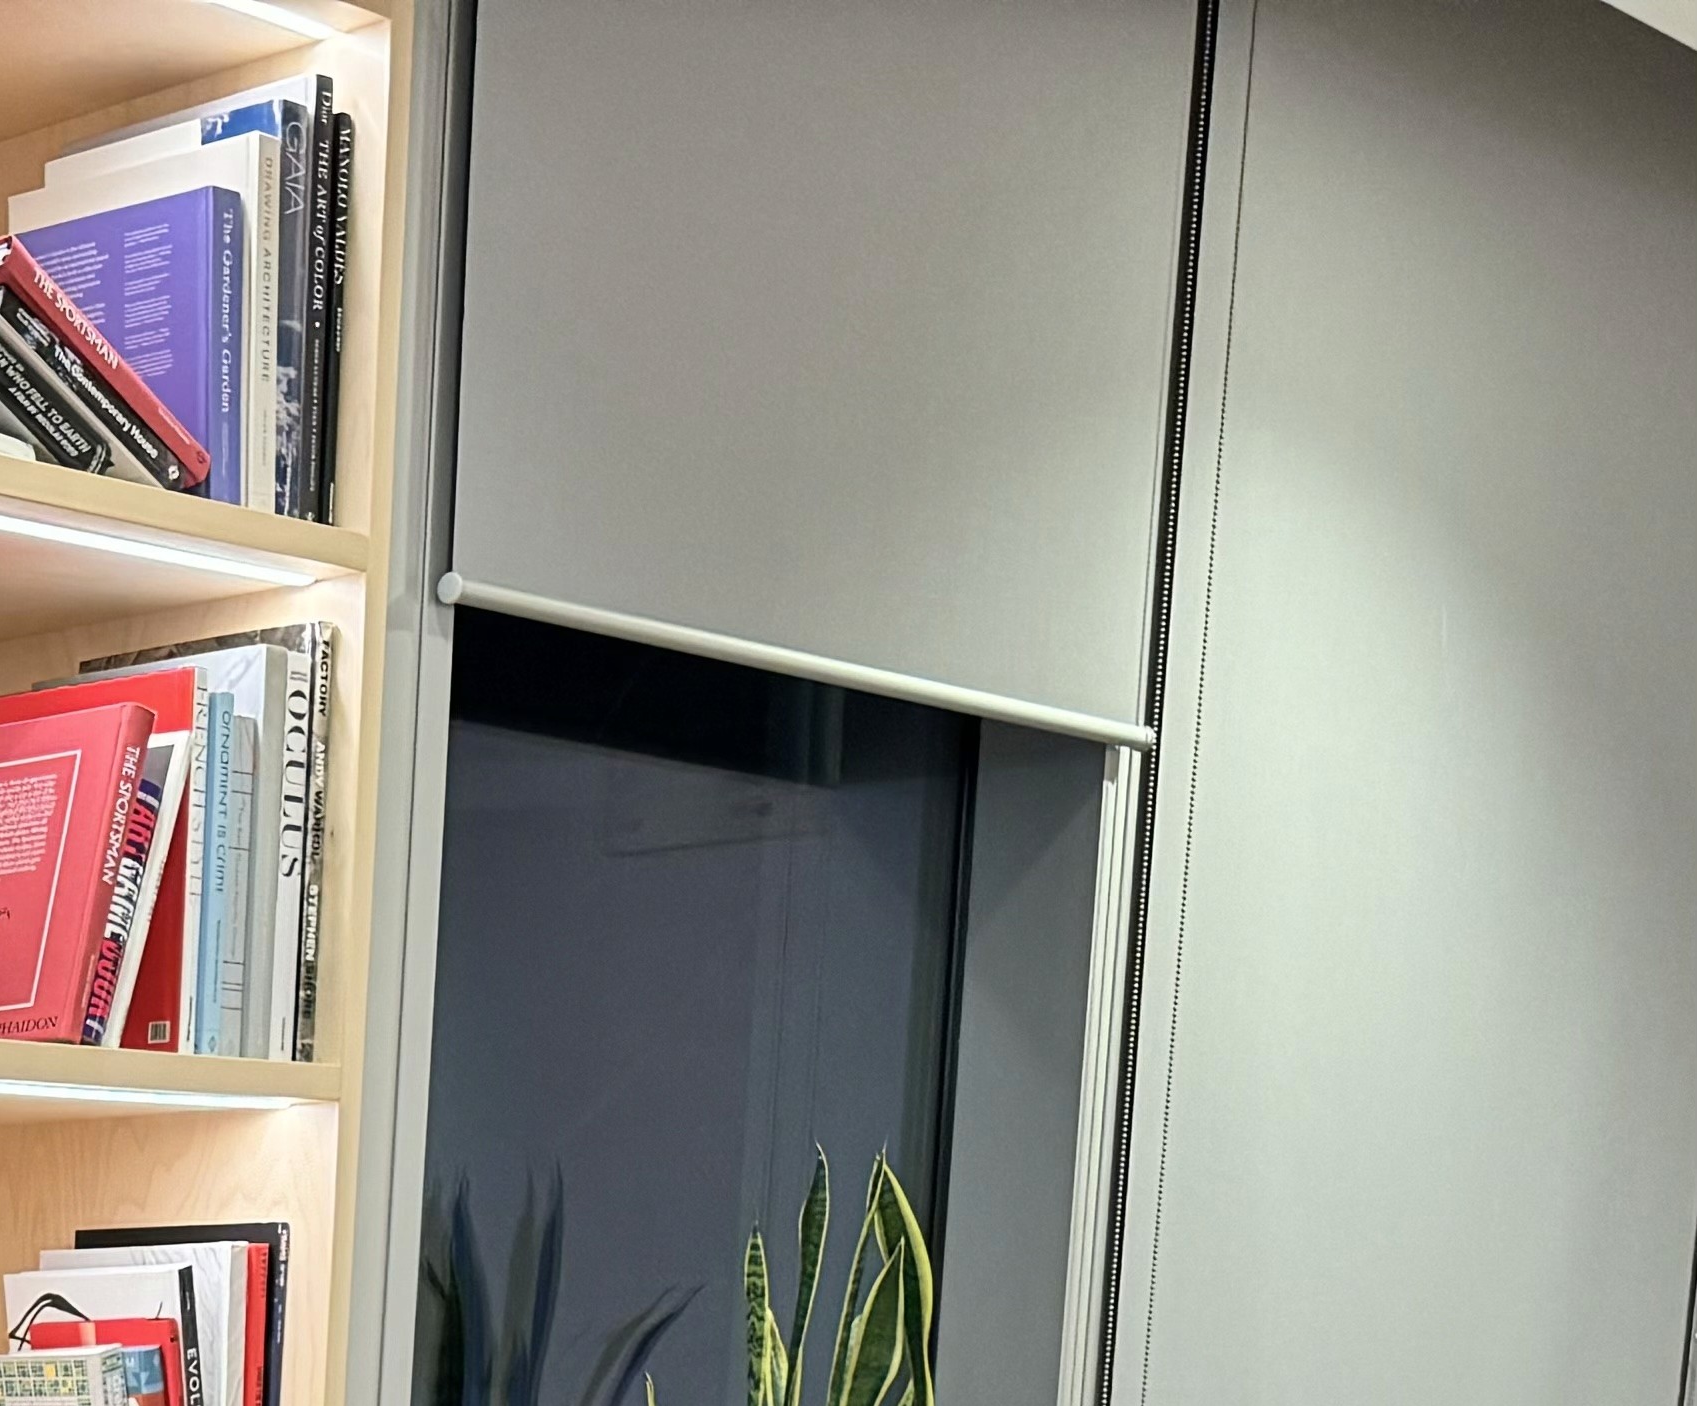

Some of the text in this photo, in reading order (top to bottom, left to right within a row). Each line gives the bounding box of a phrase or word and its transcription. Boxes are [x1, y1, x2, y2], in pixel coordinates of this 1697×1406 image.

[284, 121, 307, 215] GAIA
[317, 141, 330, 180] THE
[317, 184, 329, 224] ART
[222, 208, 234, 244] The
[261, 157, 274, 383] DRAWING ARCHITECTURE
[313, 225, 326, 243] of
[33, 266, 56, 299] THE
[55, 295, 120, 370] SPORTSMAN
[221, 249, 234, 342] Gardener's
[311, 244, 326, 312] COLOR
[6, 365, 31, 392] WHO
[23, 380, 49, 412] FELL
[47, 409, 65, 427] TO
[59, 420, 92, 454] EARTH
[54, 344, 159, 460] The Contemporary House
[220, 350, 232, 413] Garden
[317, 639, 331, 717] FACTORY
[101, 745, 140, 885] THE SPORTSMAN
[280, 689, 308, 878] OCULUS
[311, 741, 327, 863] ANDY WARHOL
[306, 884, 320, 964] STEPHEN
